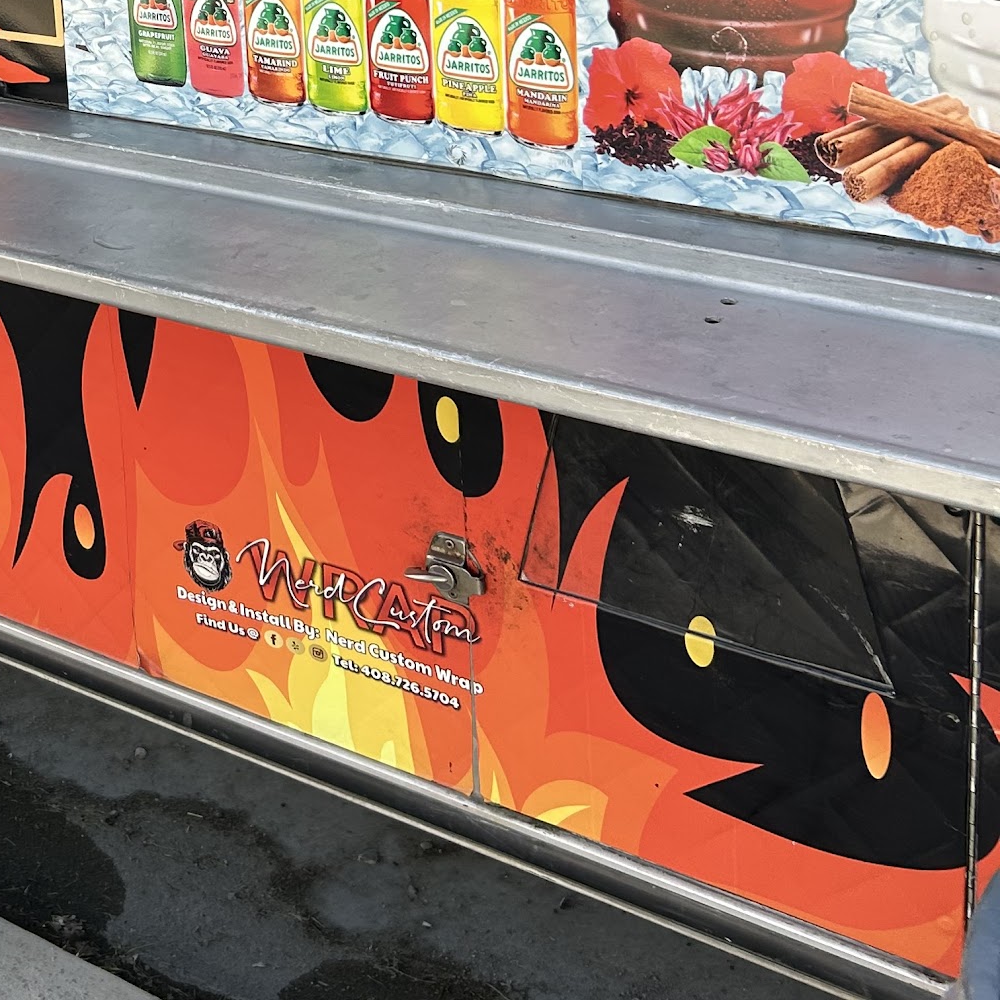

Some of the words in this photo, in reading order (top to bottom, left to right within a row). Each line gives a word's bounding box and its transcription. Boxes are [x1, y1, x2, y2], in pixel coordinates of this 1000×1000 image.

[139, 10, 171, 22] JARRITOS
[138, 30, 175, 40] GRAPEFRUIT
[196, 26, 231, 39] JARRITOS
[200, 44, 230, 55] GUAVA
[255, 36, 293, 50] JARRITOS
[315, 43, 355, 58] JARRITOS
[378, 50, 421, 65] JARRITOS
[253, 54, 298, 68] TAMARIND
[445, 60, 490, 74] JARRITOS
[322, 64, 351, 75] LIME
[373, 69, 399, 82] FRUIT
[400, 74, 429, 84] PUNCH
[517, 67, 565, 83] JARRITOS
[442, 78, 497, 93] PINEAPPLE
[516, 88, 568, 102] MANDARIN
[195, 612, 226, 631] Find
[228, 621, 246, 637] Us
[176, 585, 227, 612] Design
[240, 603, 292, 630] Install
[293, 619, 321, 640] By:
[325, 628, 367, 654] Nerd
[368, 643, 433, 677] Custom
[434, 665, 484, 695] Wrap
[332, 654, 360, 673] Tel:
[361, 664, 461, 710] 408.726.5704
